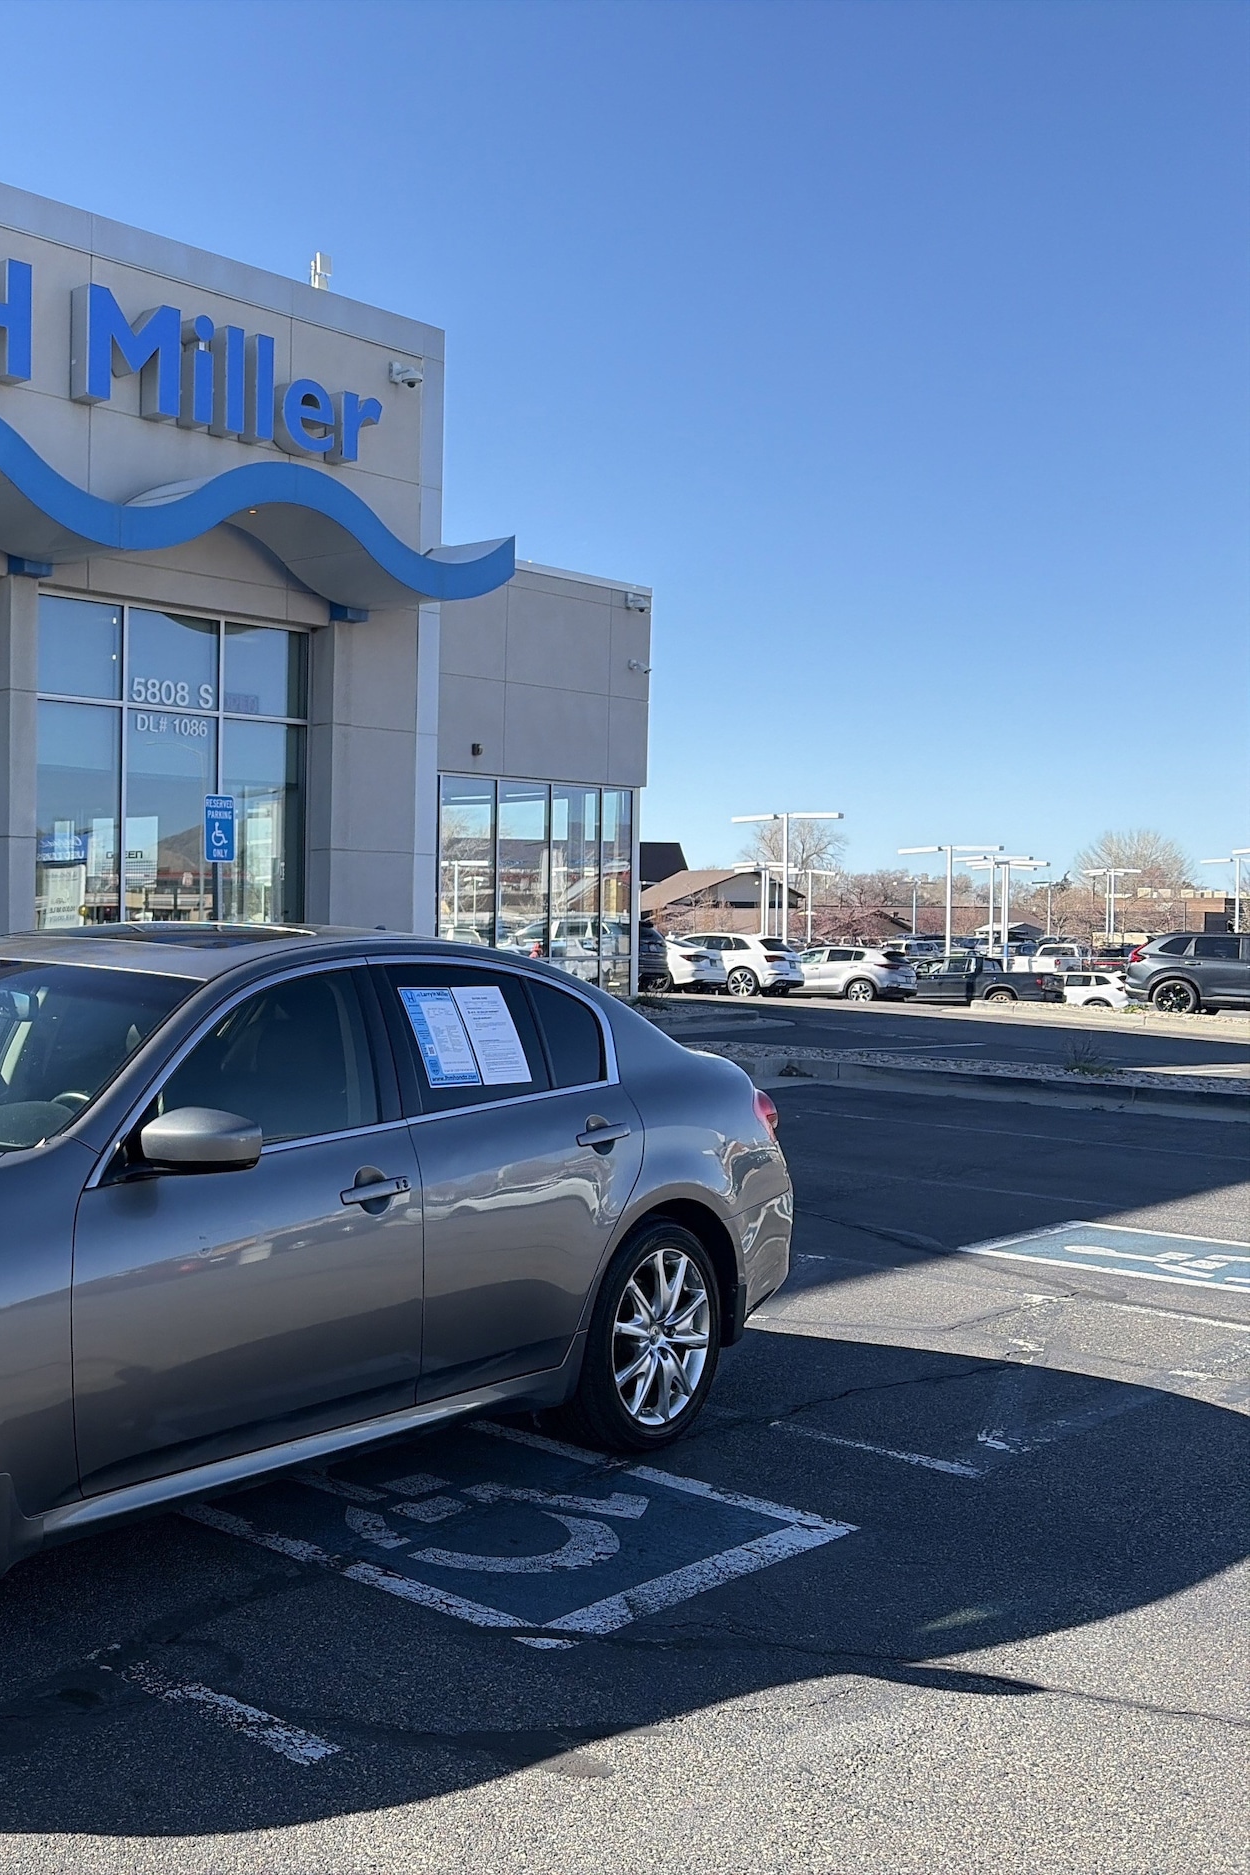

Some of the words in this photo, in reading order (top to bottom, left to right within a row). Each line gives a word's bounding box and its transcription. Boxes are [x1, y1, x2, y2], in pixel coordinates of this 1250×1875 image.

[75, 283, 383, 463] Miller
[132, 677, 189, 706] 5808
[198, 684, 213, 709] S
[137, 714, 167, 732] DL#
[173, 719, 208, 737] 1086
[206, 799, 234, 809] RESERVED
[207, 810, 232, 820] PARKING
[213, 848, 229, 858] ONLY
